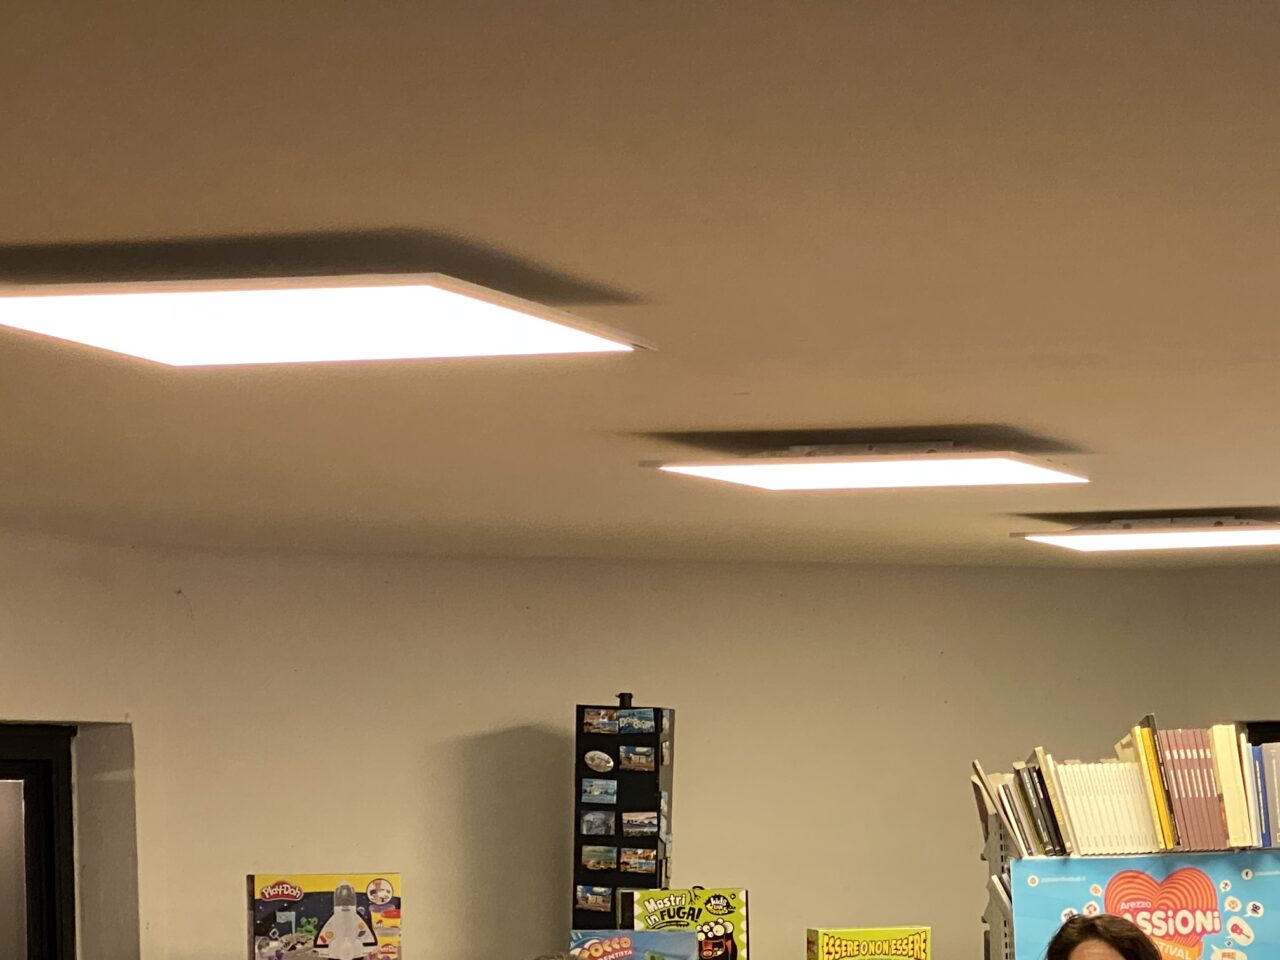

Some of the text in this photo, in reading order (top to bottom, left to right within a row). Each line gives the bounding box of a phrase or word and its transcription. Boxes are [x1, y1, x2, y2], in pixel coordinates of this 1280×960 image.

[644, 894, 687, 914] Mostri
[1120, 901, 1152, 910] Arezzo
[660, 906, 703, 923] FUGA!
[868, 940, 890, 956] NON
